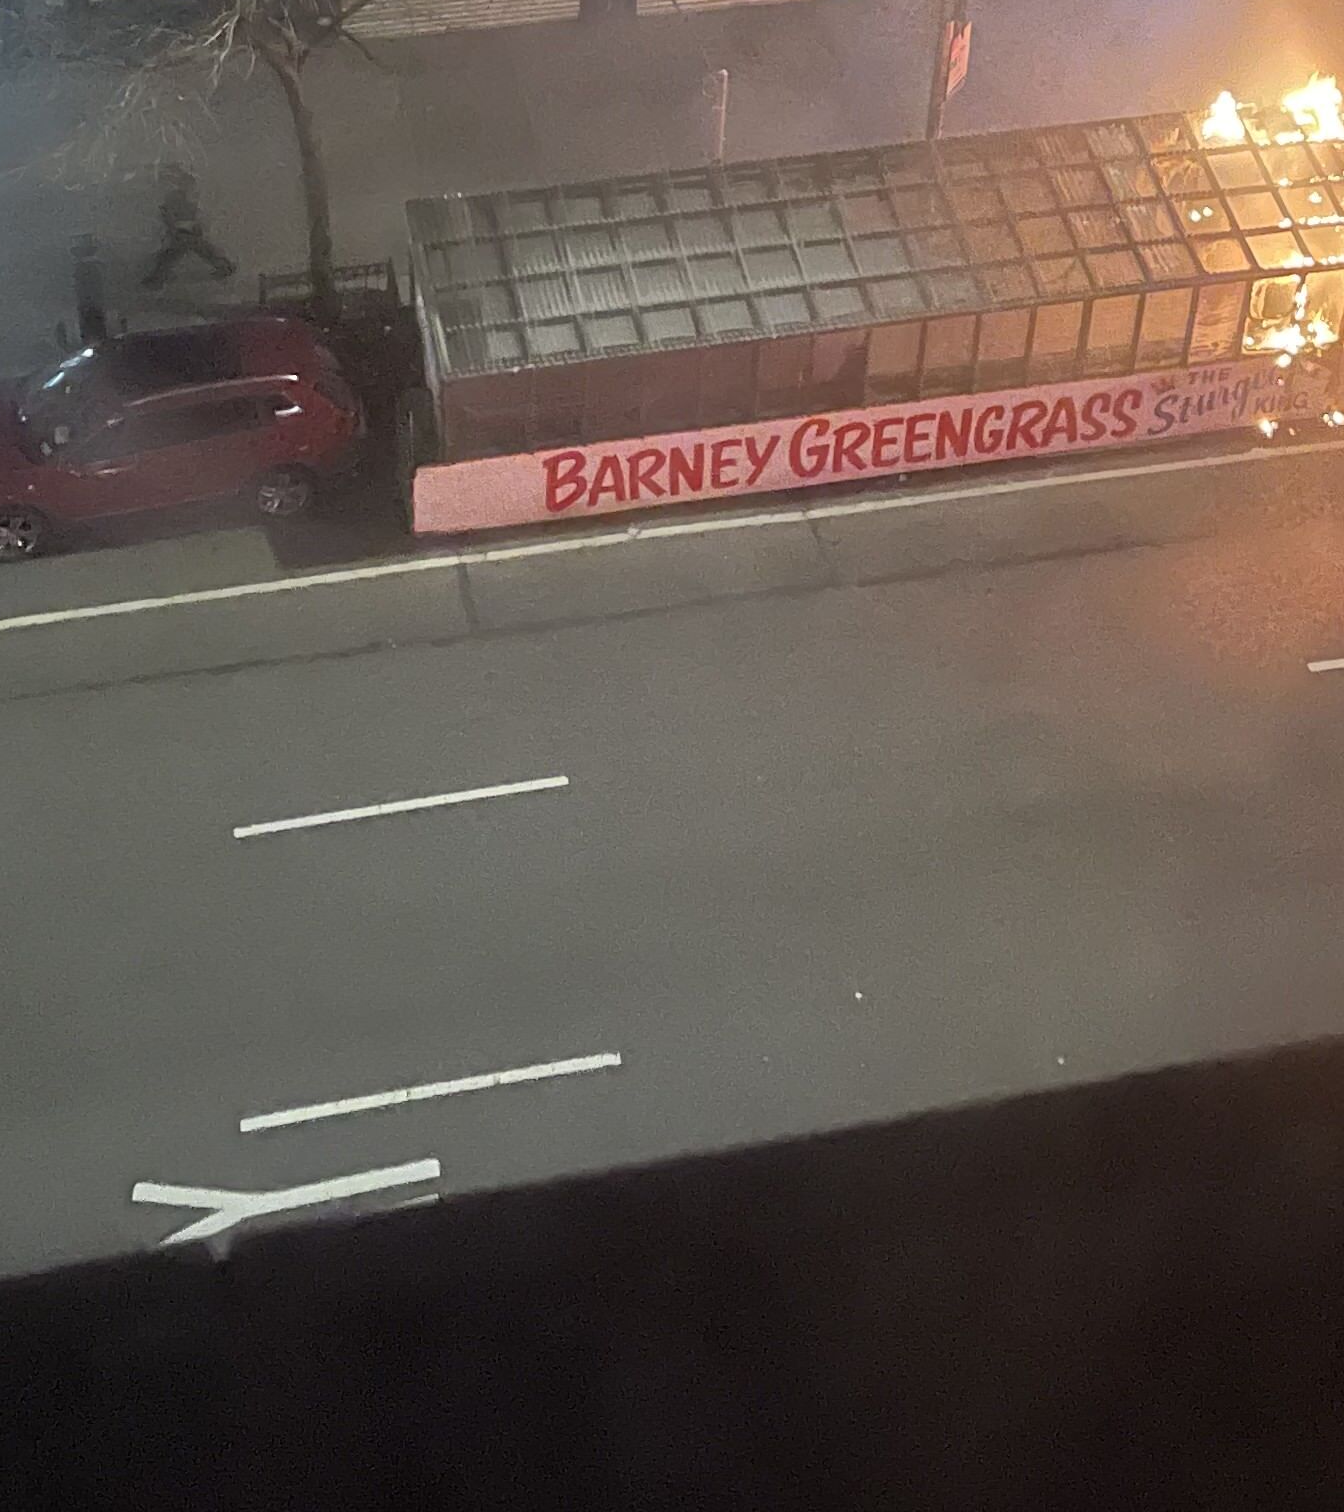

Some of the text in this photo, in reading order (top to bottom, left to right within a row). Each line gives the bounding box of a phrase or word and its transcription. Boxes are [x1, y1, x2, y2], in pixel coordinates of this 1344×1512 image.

[1187, 367, 1233, 385] THE
[542, 434, 783, 514] BARNEY
[788, 388, 1143, 479] GREENGRASS
